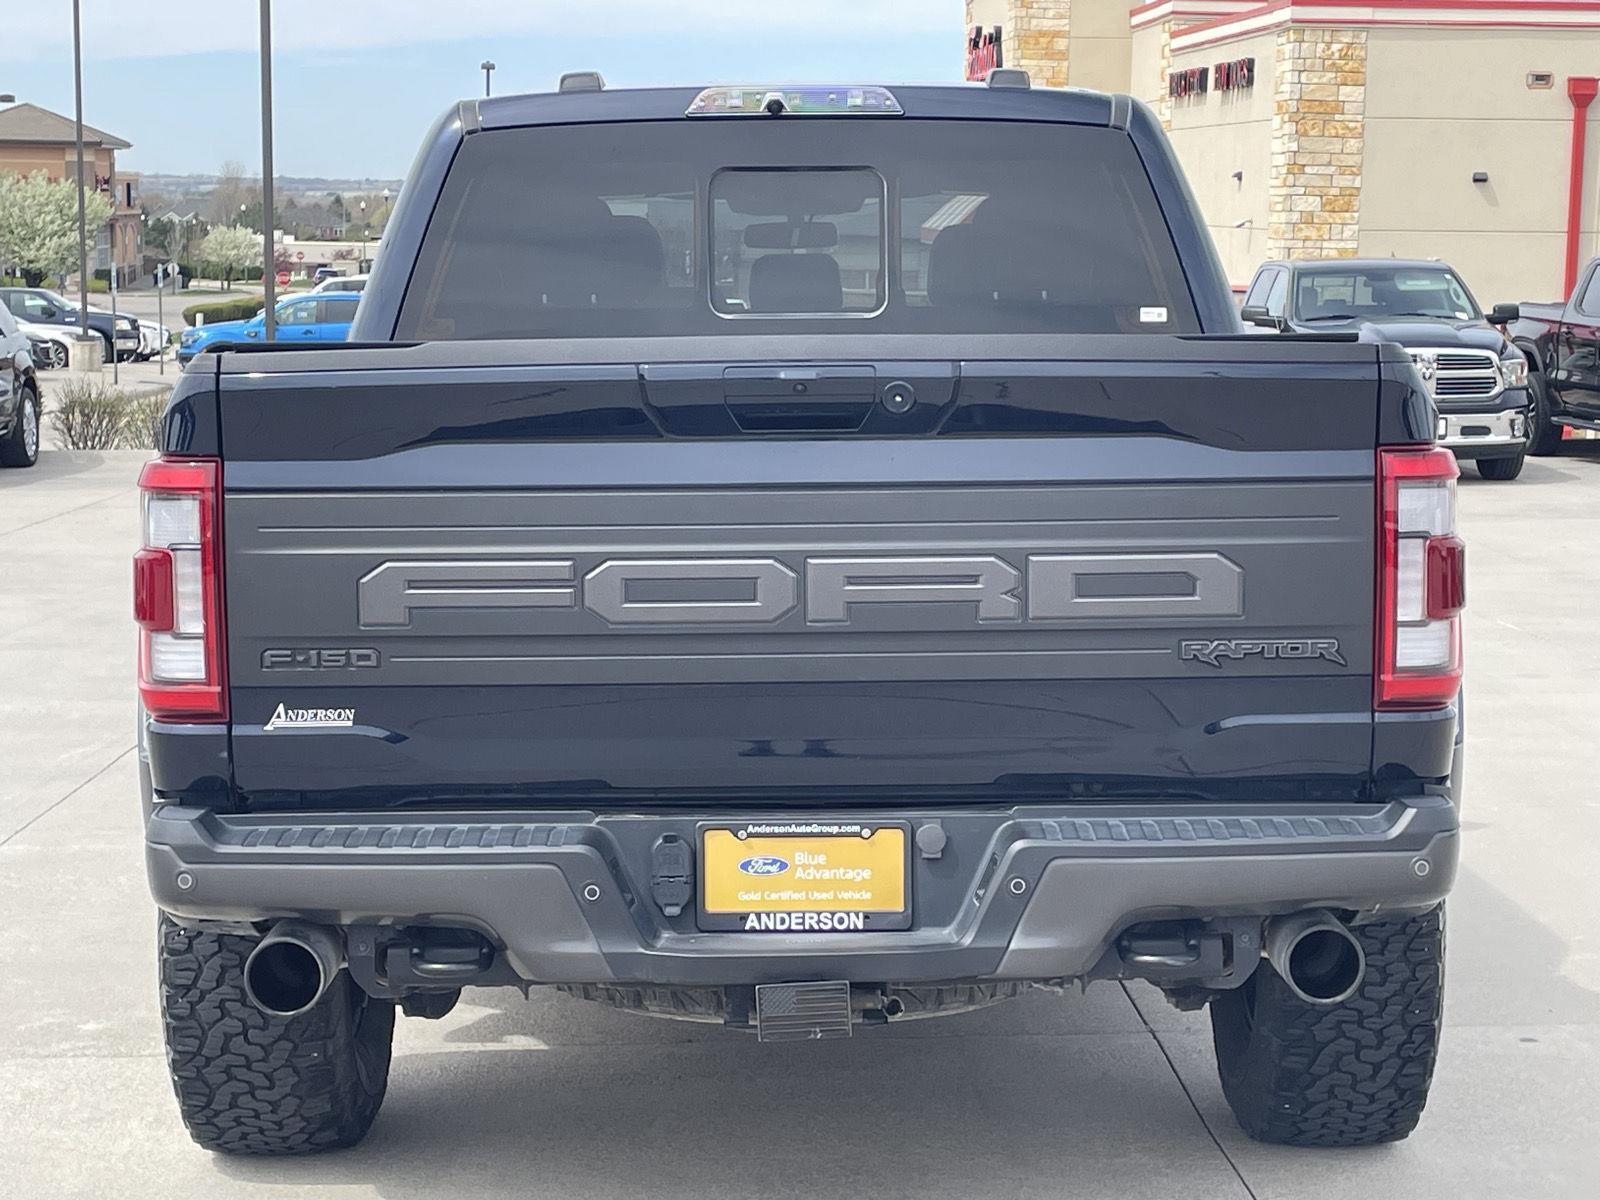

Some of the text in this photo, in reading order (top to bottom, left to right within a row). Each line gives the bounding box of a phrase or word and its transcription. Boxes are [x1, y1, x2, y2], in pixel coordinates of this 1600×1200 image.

[357, 552, 1245, 630] FORD
[261, 647, 381, 672] F-150
[1180, 637, 1347, 667] RAPTOR
[746, 824, 861, 834] AndersonAutoGroup.com
[747, 857, 780, 874] Ford
[794, 852, 827, 865] Blue
[794, 867, 872, 882] Advantage
[737, 890, 873, 901] Gold Certified Used Vehicle
[744, 912, 864, 930] ANDERSON
